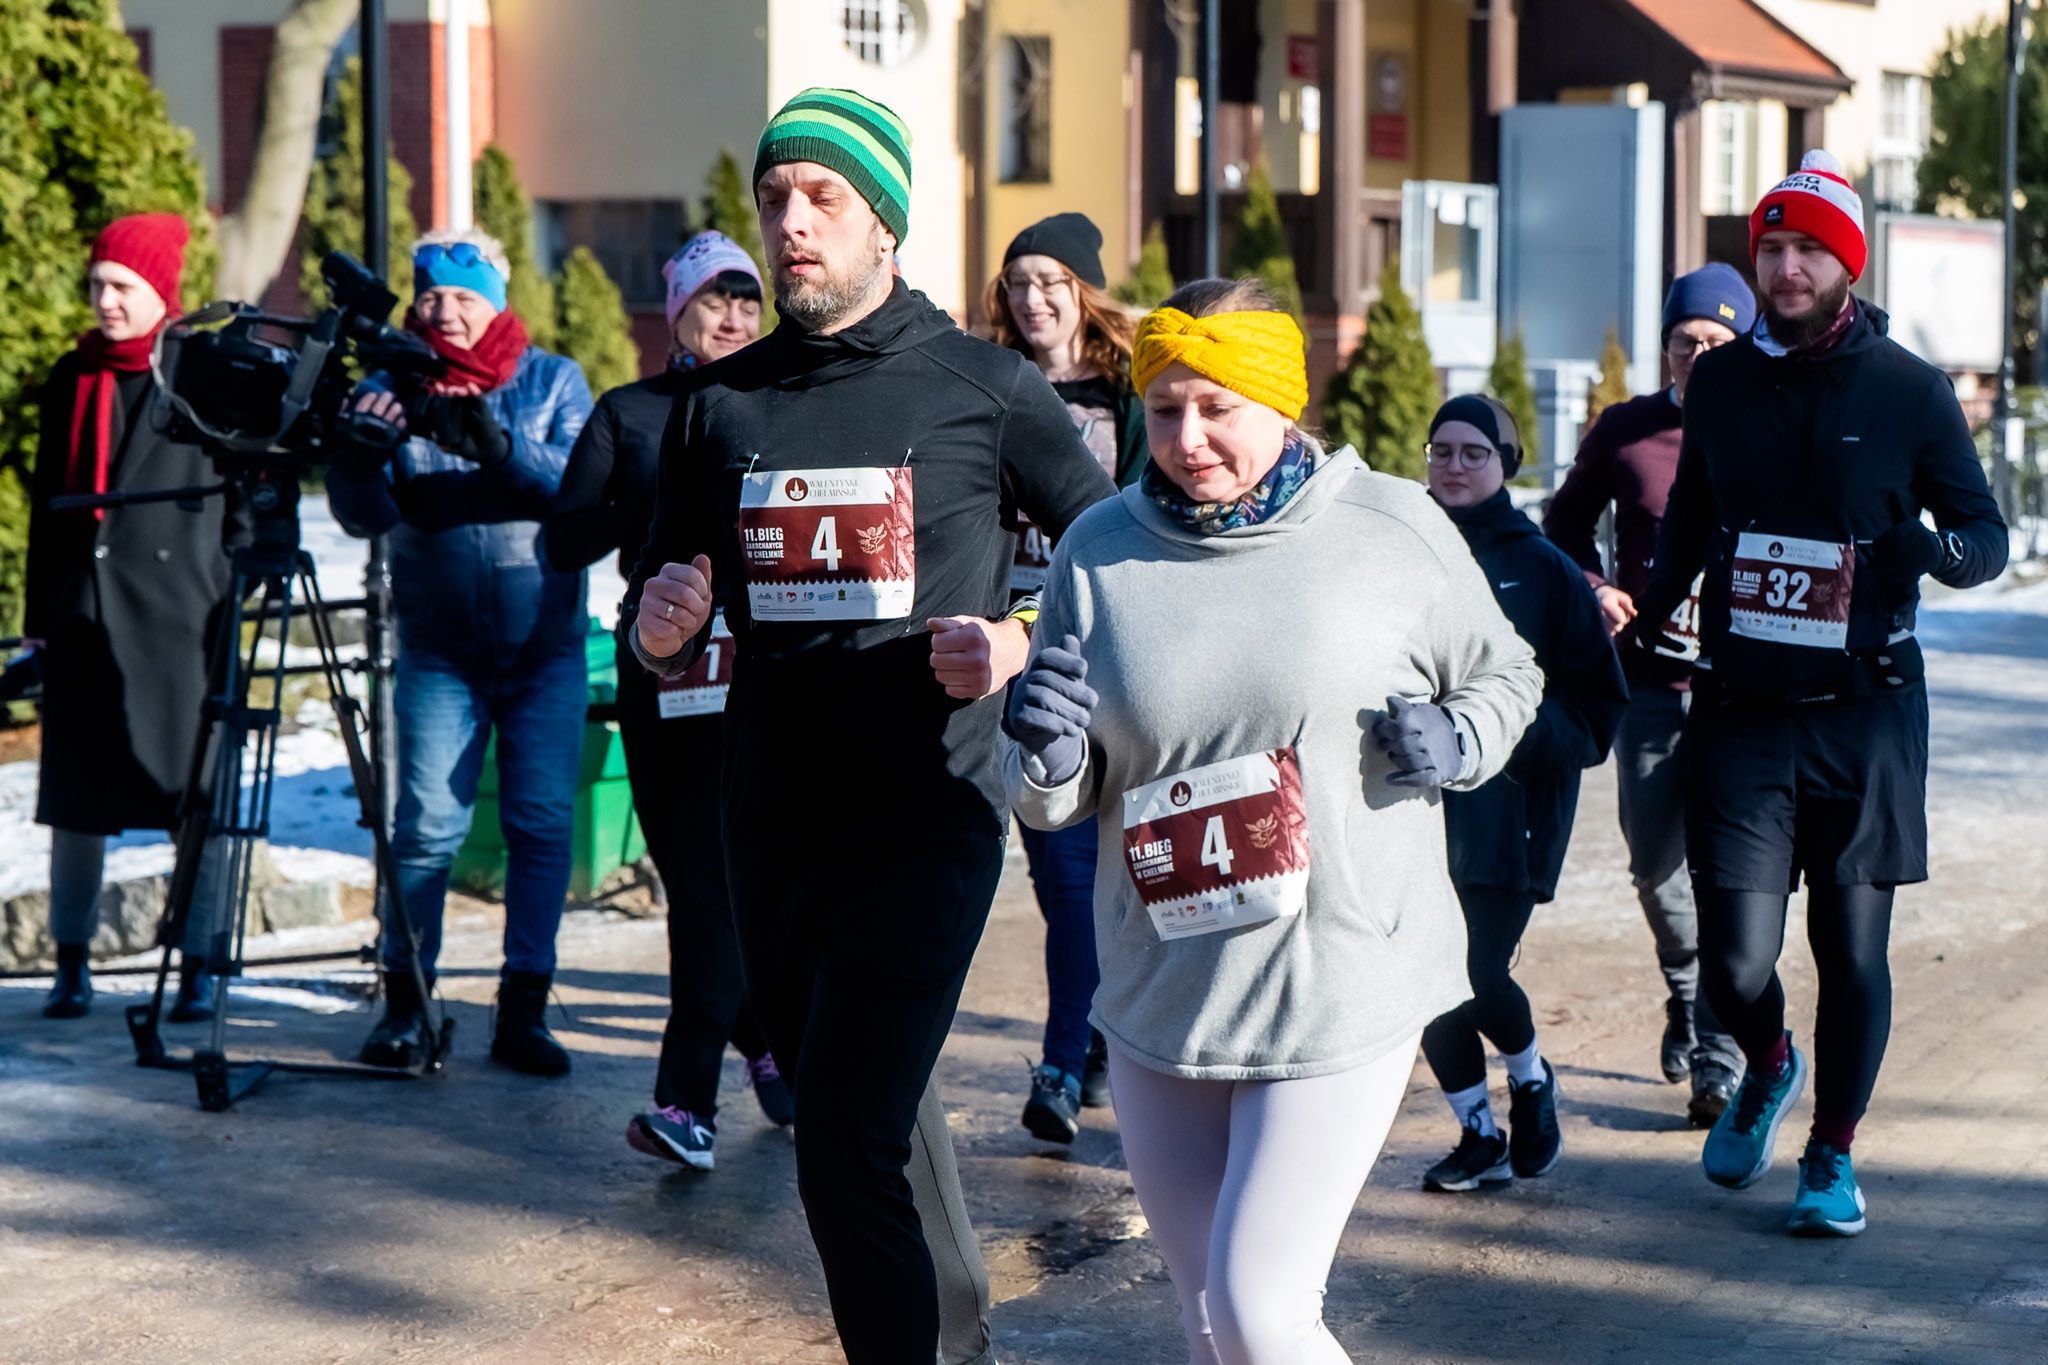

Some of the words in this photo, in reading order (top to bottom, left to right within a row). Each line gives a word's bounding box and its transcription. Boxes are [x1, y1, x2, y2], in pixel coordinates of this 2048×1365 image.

[810, 516, 843, 571] 4
[1766, 568, 1811, 611] 32
[1200, 814, 1235, 876] 4
